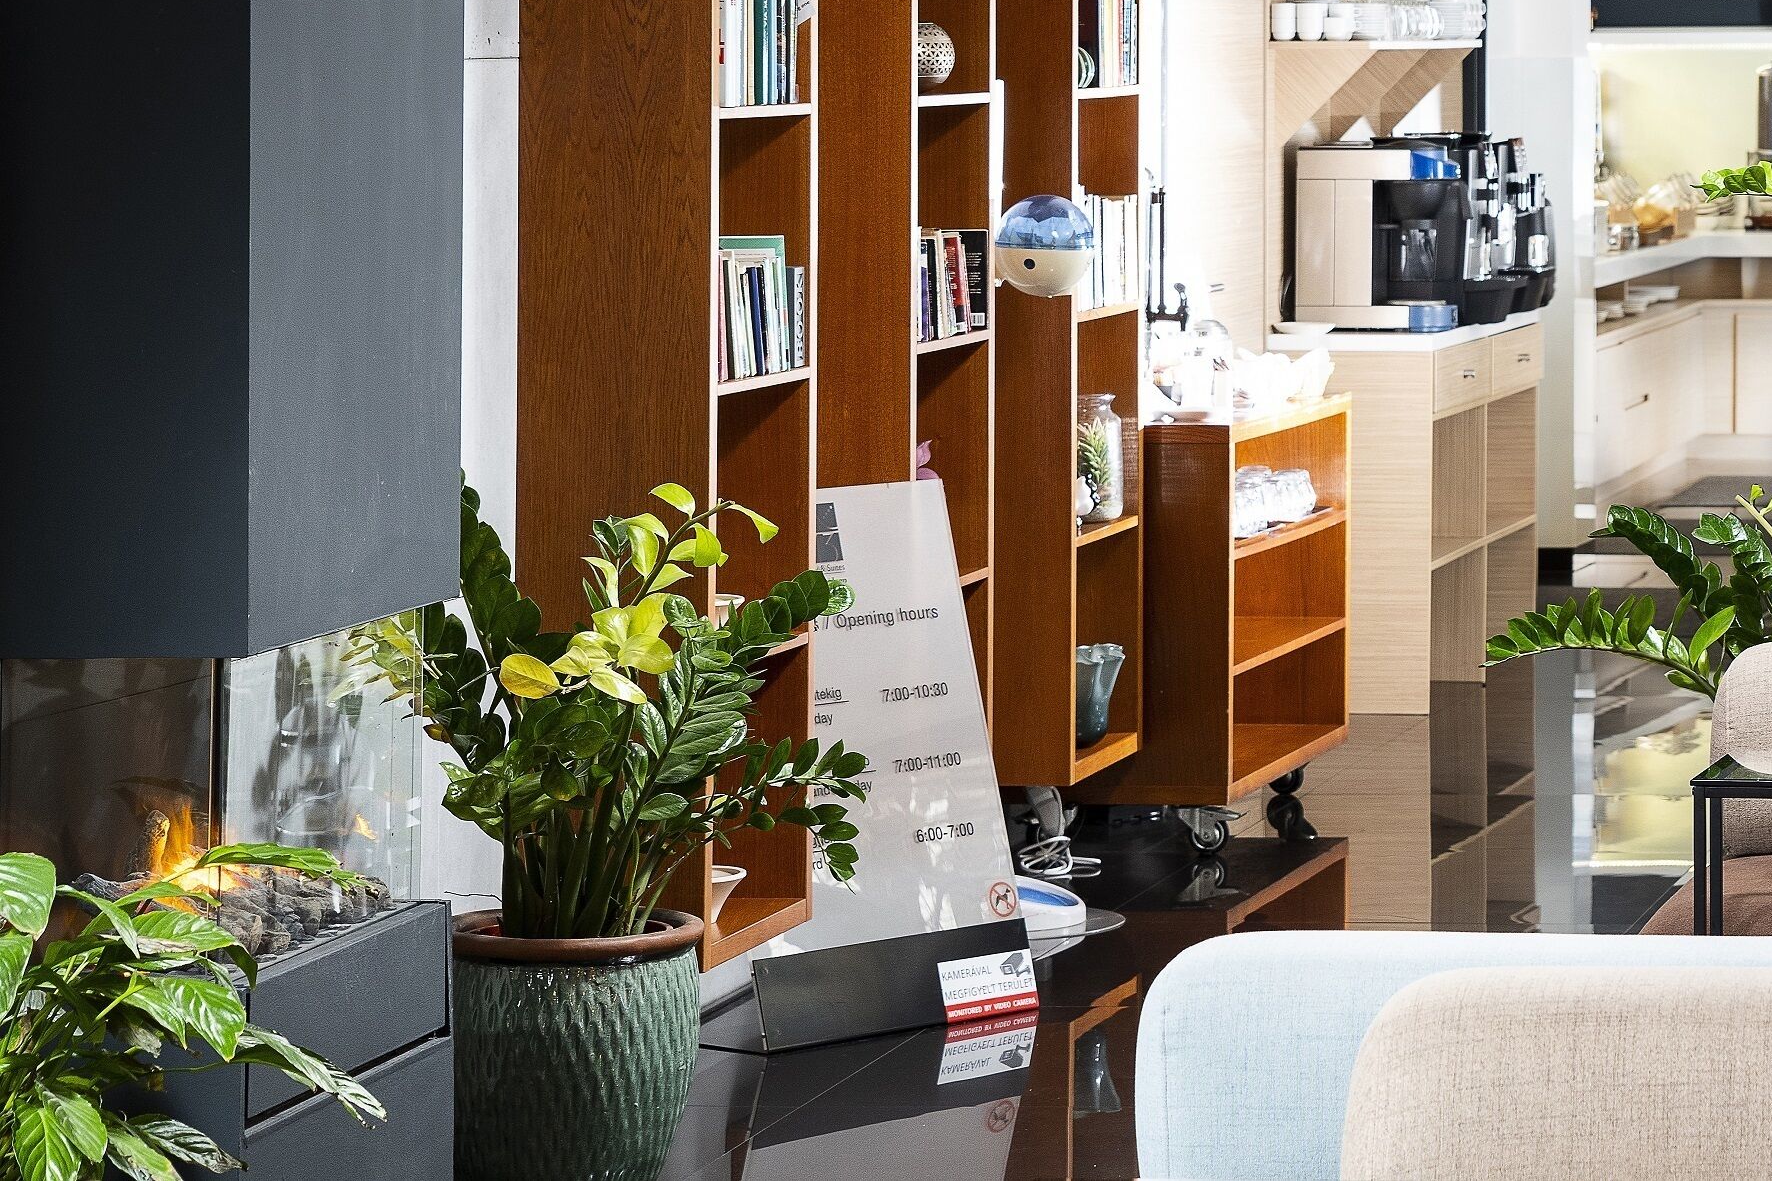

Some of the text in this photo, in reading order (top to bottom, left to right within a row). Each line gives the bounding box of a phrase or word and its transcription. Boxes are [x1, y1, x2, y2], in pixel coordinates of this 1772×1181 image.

[835, 610, 895, 631] Opening
[899, 607, 939, 622] hours
[815, 682, 949, 703] tekig 7:00-10:30
[895, 752, 962, 773] 7:00-11:00
[916, 822, 975, 843] 6:00-7:00
[941, 965, 993, 982] KAMERÁVAL
[944, 984, 997, 1001] MEGFIGYELT
[948, 997, 1037, 1018] MONITORED BY VIDEO CAMERA
